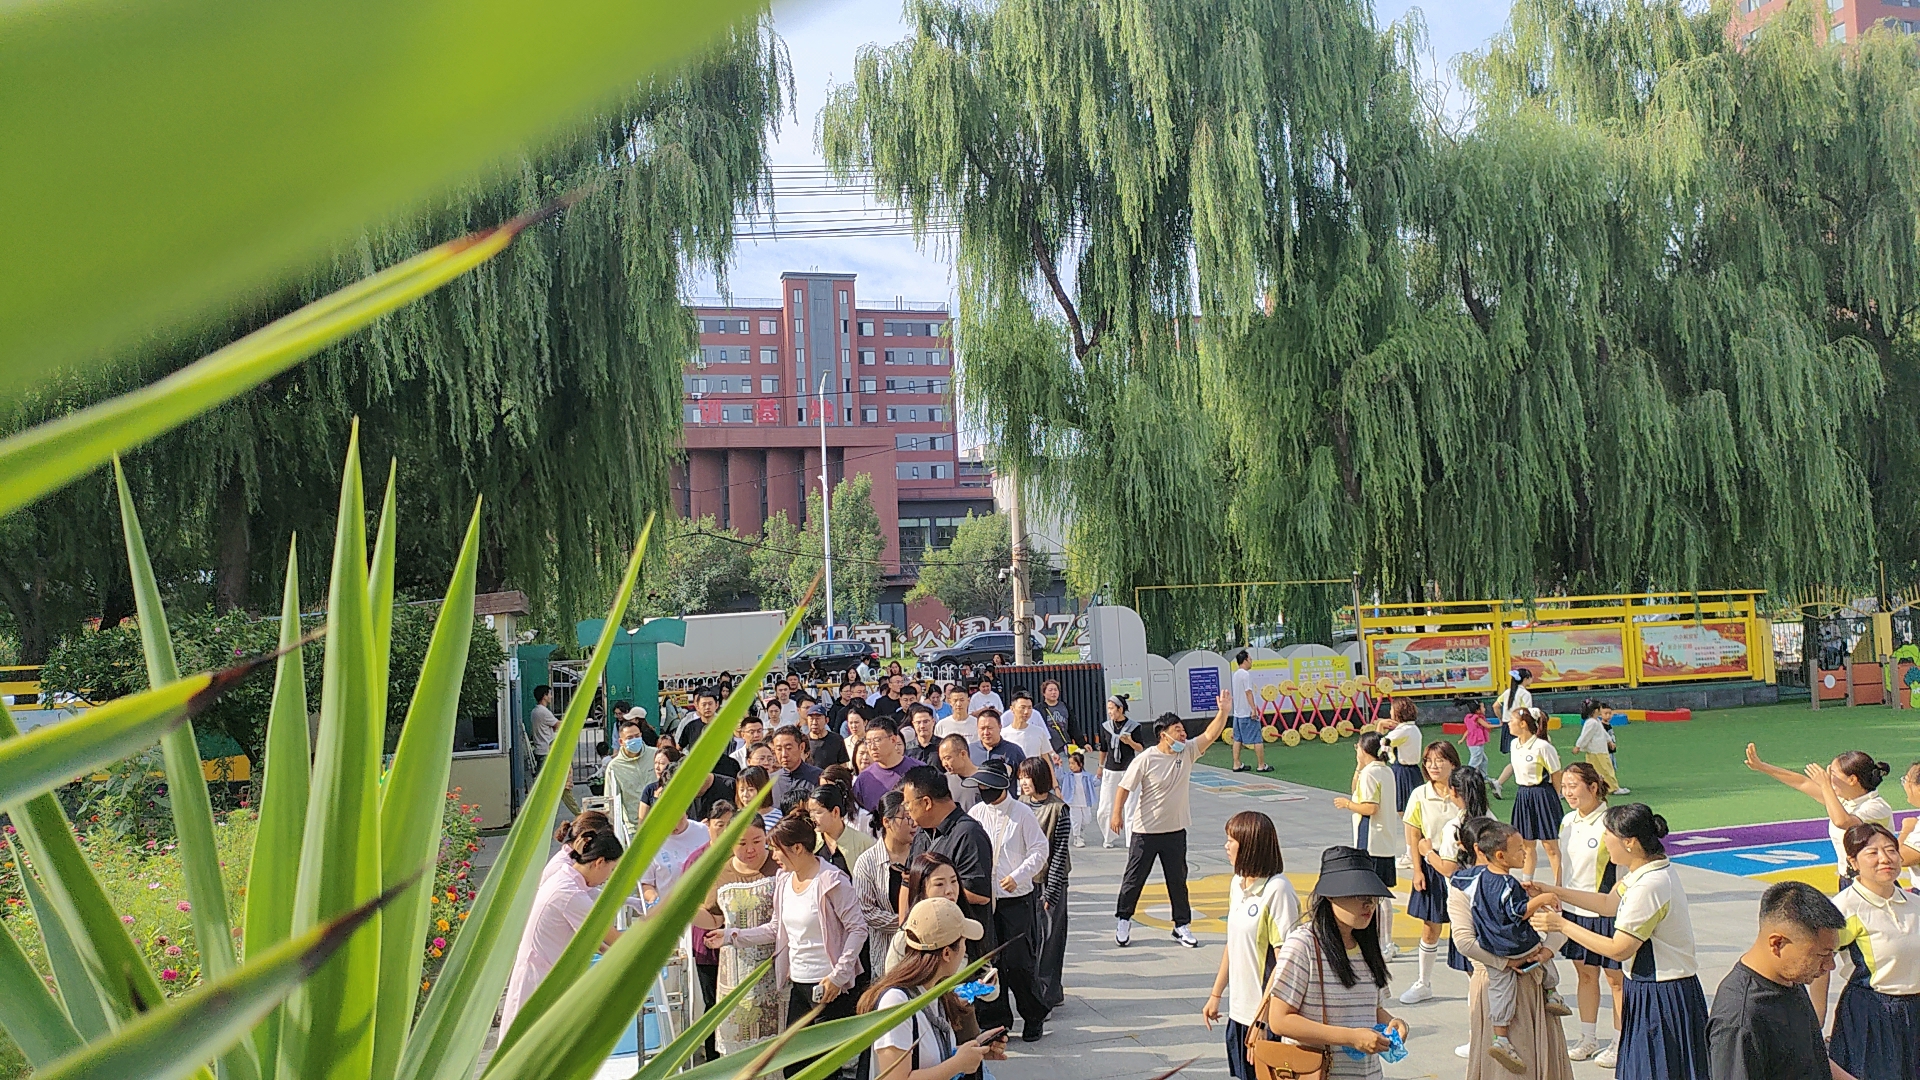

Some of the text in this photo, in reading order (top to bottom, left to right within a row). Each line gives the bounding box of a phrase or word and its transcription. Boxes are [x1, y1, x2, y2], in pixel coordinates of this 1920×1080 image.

[1521, 648, 1565, 658] 党在我心中
